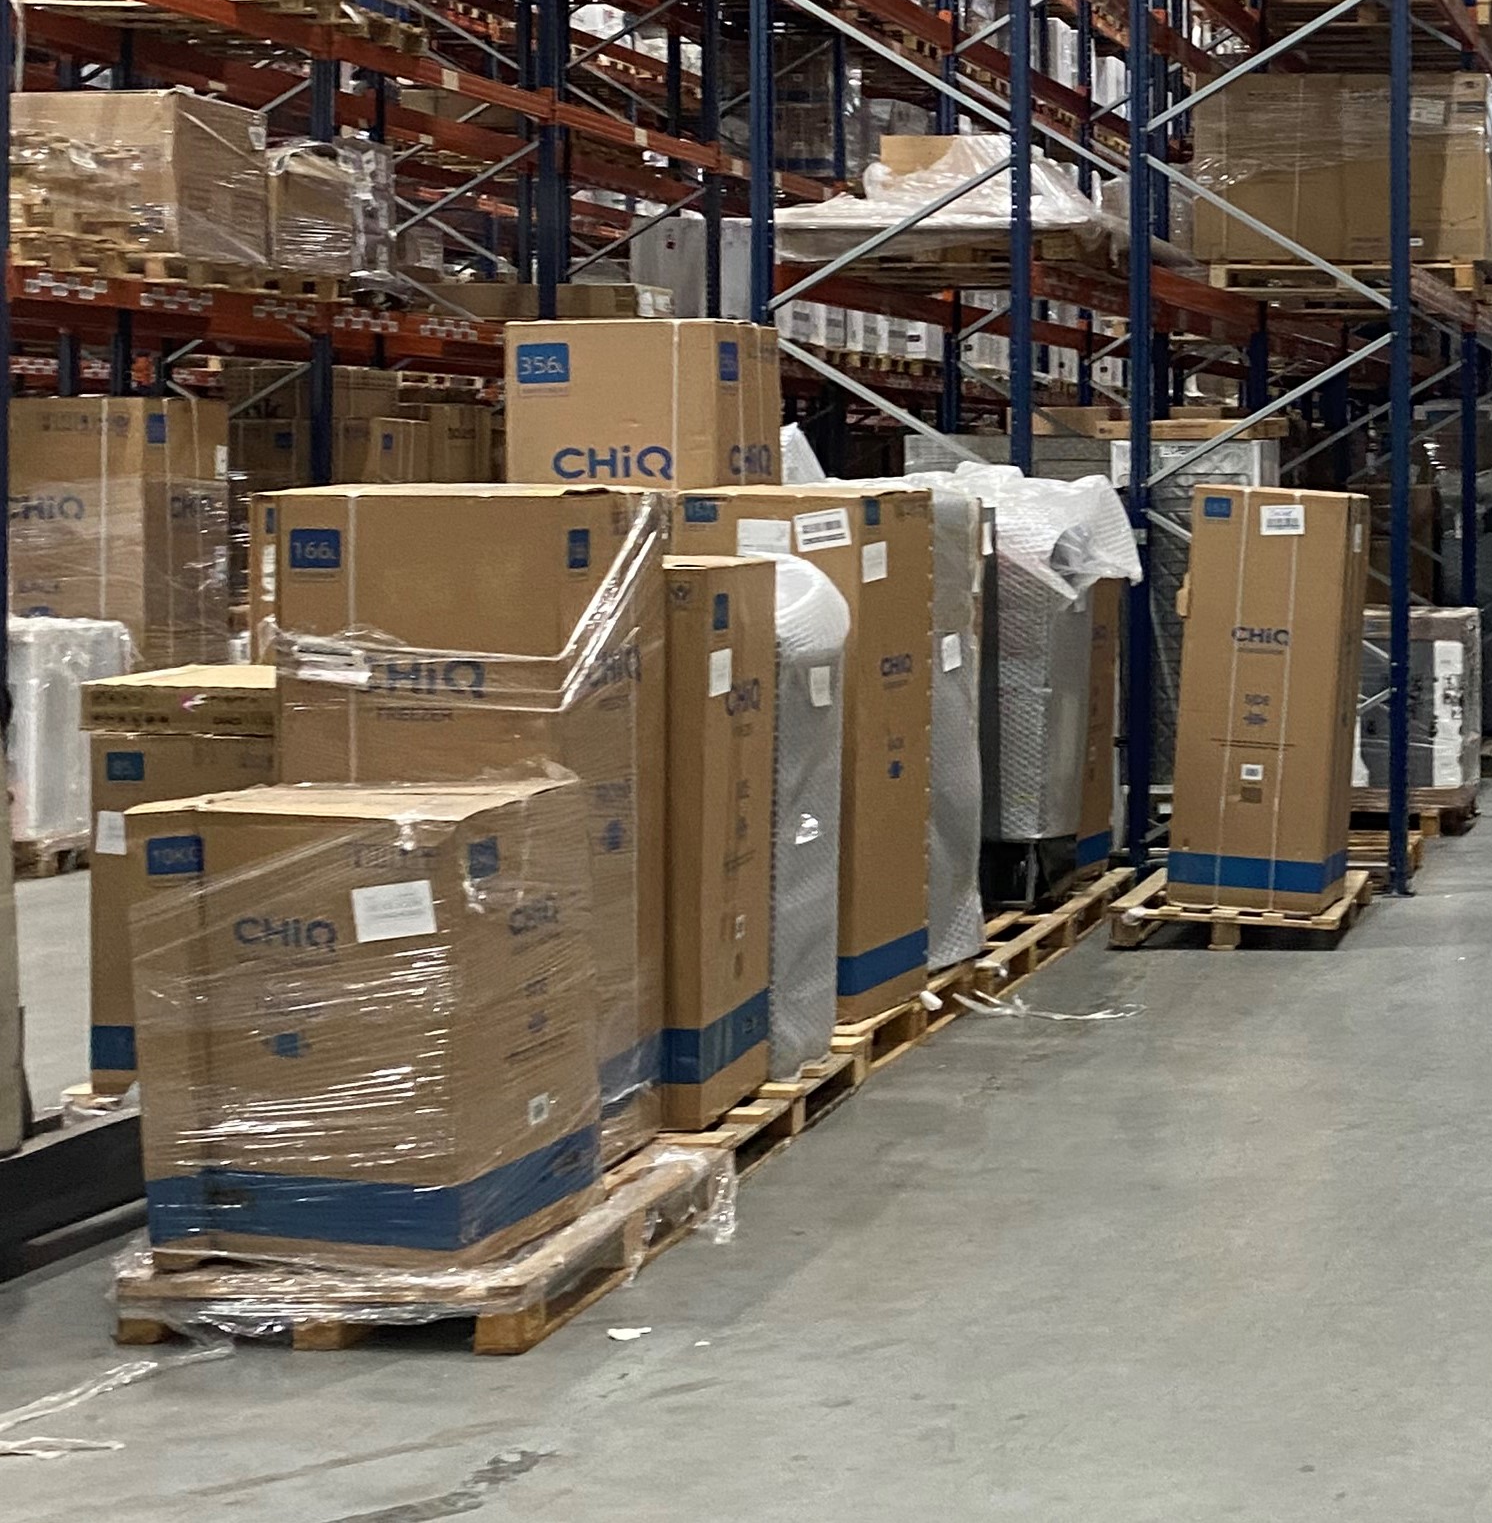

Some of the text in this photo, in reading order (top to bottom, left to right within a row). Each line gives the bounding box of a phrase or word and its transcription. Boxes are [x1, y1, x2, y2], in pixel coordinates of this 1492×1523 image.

[552, 445, 674, 481] CHiQ
[729, 443, 772, 477] CHiQ
[1231, 626, 1290, 647] CHiQ
[233, 916, 339, 953] CHiQ
